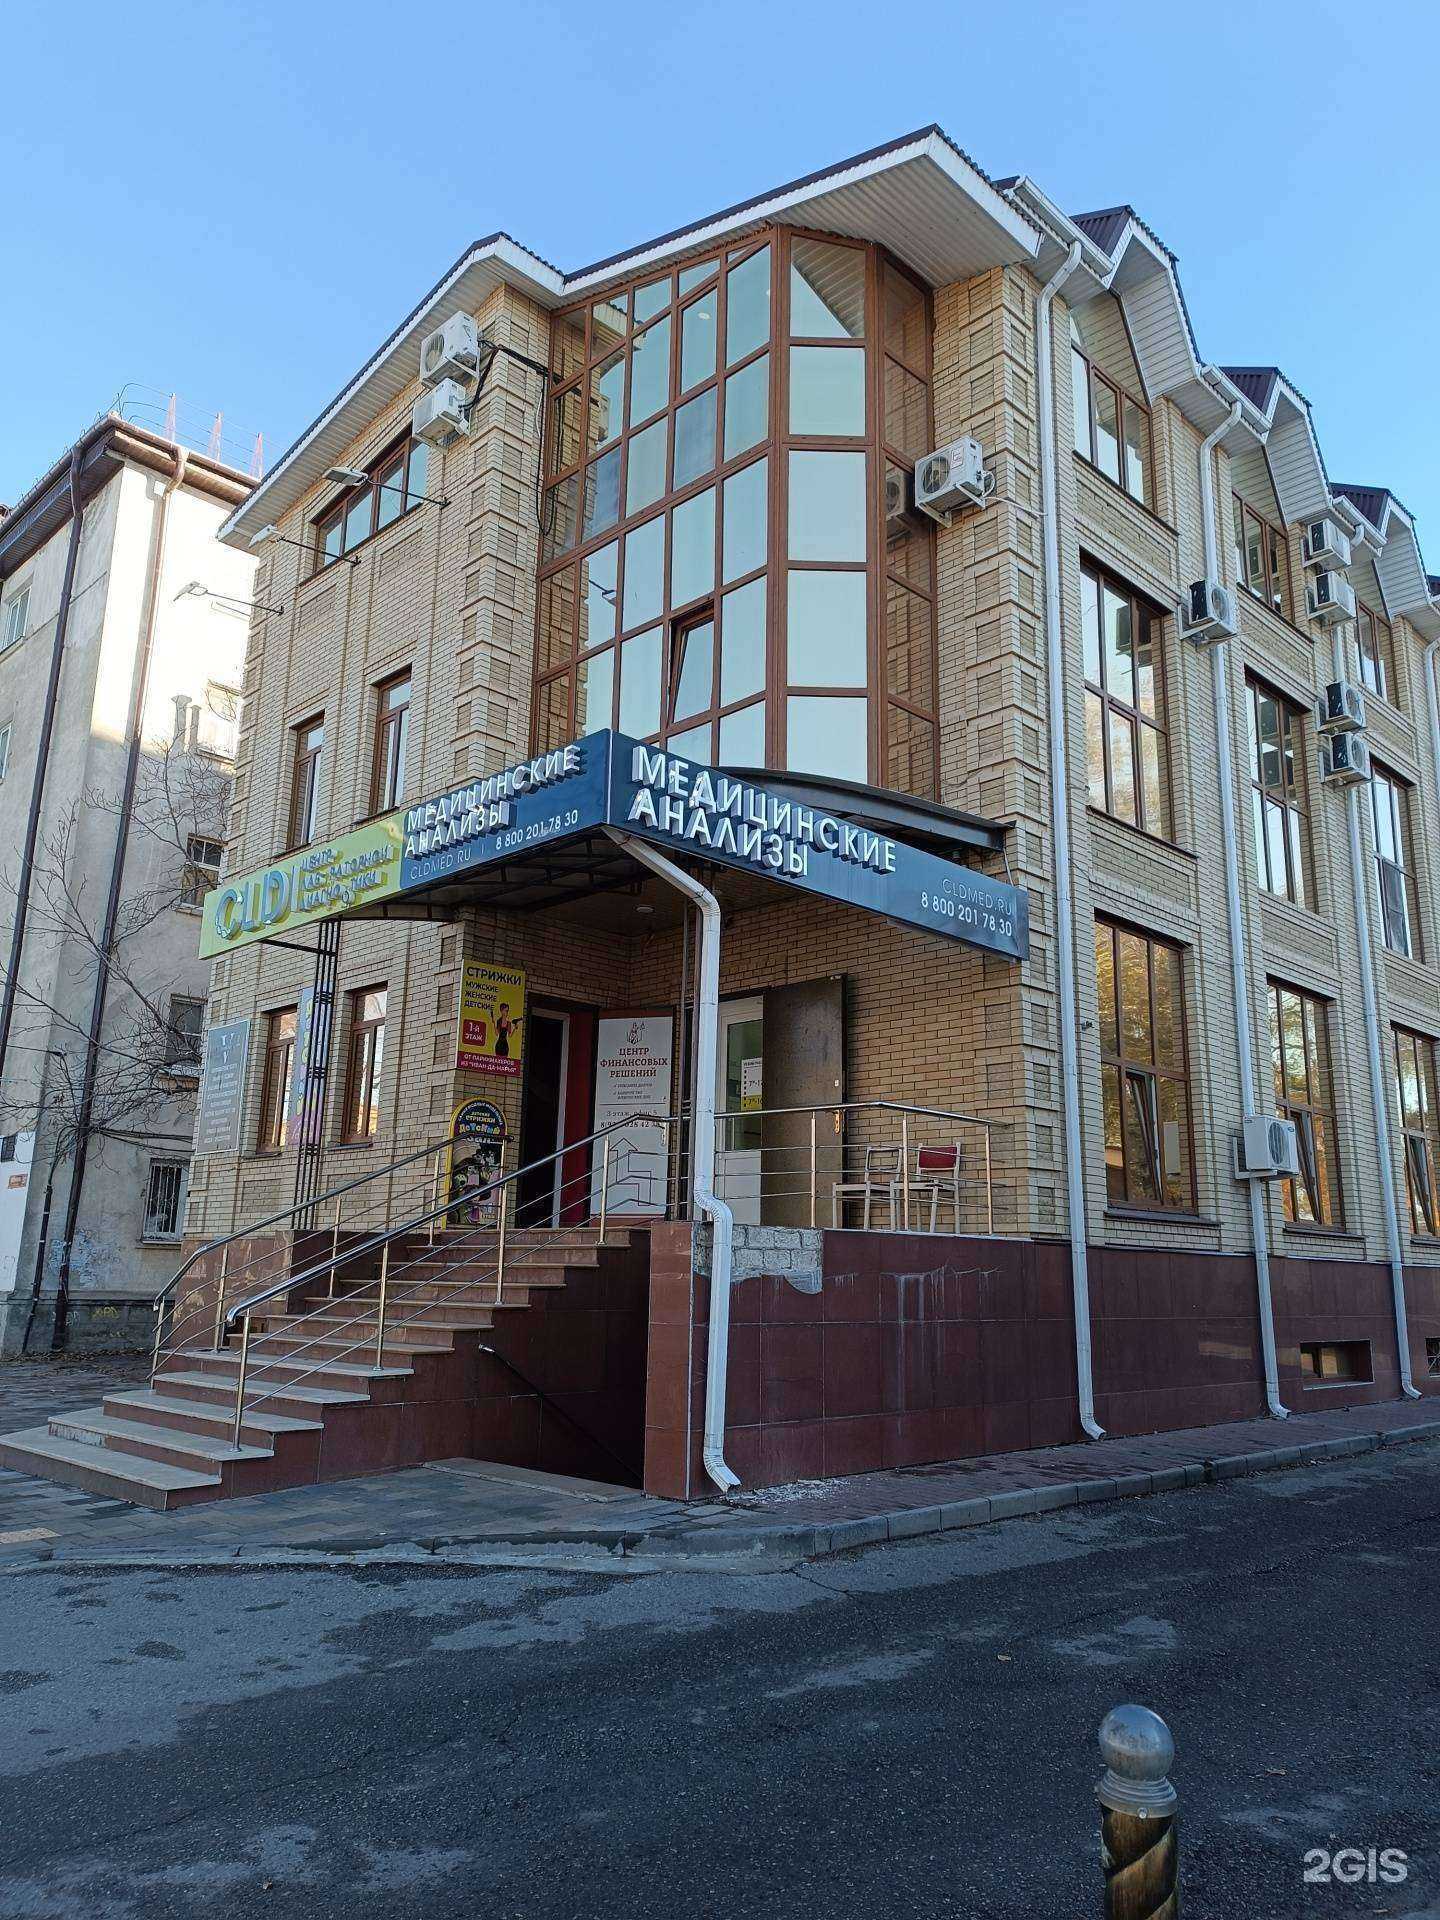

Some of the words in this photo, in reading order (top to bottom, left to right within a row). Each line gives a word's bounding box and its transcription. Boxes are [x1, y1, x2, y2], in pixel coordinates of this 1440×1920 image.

[407, 744, 581, 833] МЕДИЦИНСКИЕ
[632, 745, 897, 873] МЕДИЦИНСКИЕ
[405, 800, 512, 859] АНАЛИЗЫ
[495, 836, 503, 850] 8
[504, 829, 524, 847] 800
[525, 821, 544, 841] 201
[548, 815, 562, 833] 78
[564, 809, 579, 827] 30
[628, 787, 809, 877] АНАЛИЗЫ
[301, 848, 336, 873] ЦЕНТР
[303, 844, 394, 890] ЛАБРАТОРНОЙ
[410, 847, 472, 880] CLDMEDRU
[942, 878, 1012, 916] CLDMED.RU
[921, 891, 929, 908] 8
[932, 895, 955, 917] 800
[958, 904, 978, 926] 201
[982, 912, 996, 931] 78
[999, 918, 1012, 937] 30
[465, 980, 499, 993] МУЖСКИЕ
[466, 966, 521, 986] СТРИЖКИ
[464, 990, 497, 1003] ЖЕНСКИЕ
[464, 1000, 495, 1011] ДЕТСКИЕ
[465, 1032, 483, 1042] ЭТАЖ
[600, 1058, 668, 1067] ФИНАНСОВЫХ
[619, 1047, 650, 1057] ЦЕНТР
[610, 1067, 656, 1077] РЕШЕНИЙ
[465, 1114, 496, 1124] СТРИЖКИ
